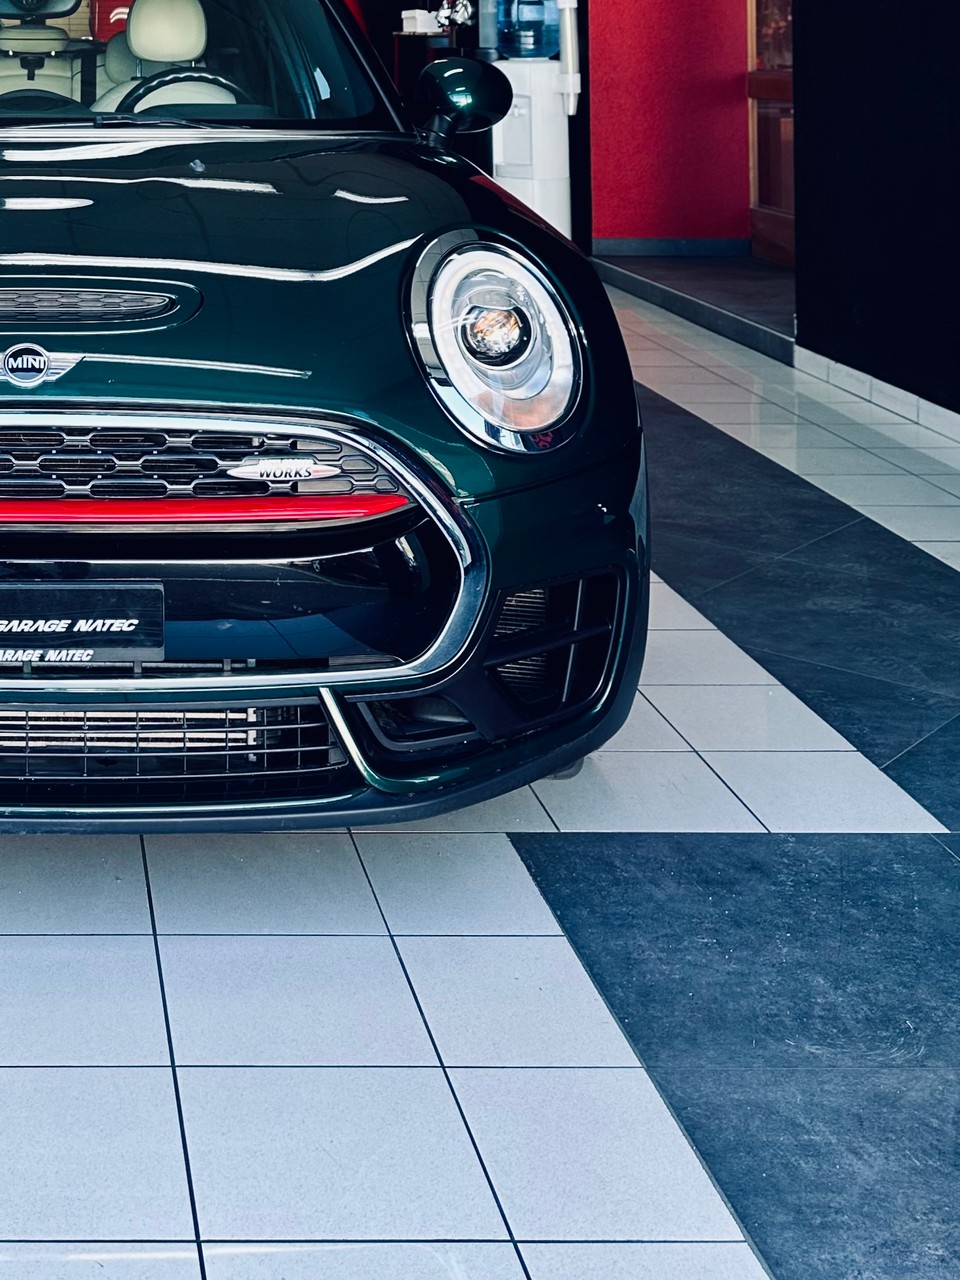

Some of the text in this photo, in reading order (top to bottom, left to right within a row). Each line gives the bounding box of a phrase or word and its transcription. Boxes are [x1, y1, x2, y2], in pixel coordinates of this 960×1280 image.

[8, 354, 45, 369] MINI
[259, 466, 312, 478] WORKS
[73, 619, 139, 632] NATEC
[44, 649, 95, 662] NATEC
